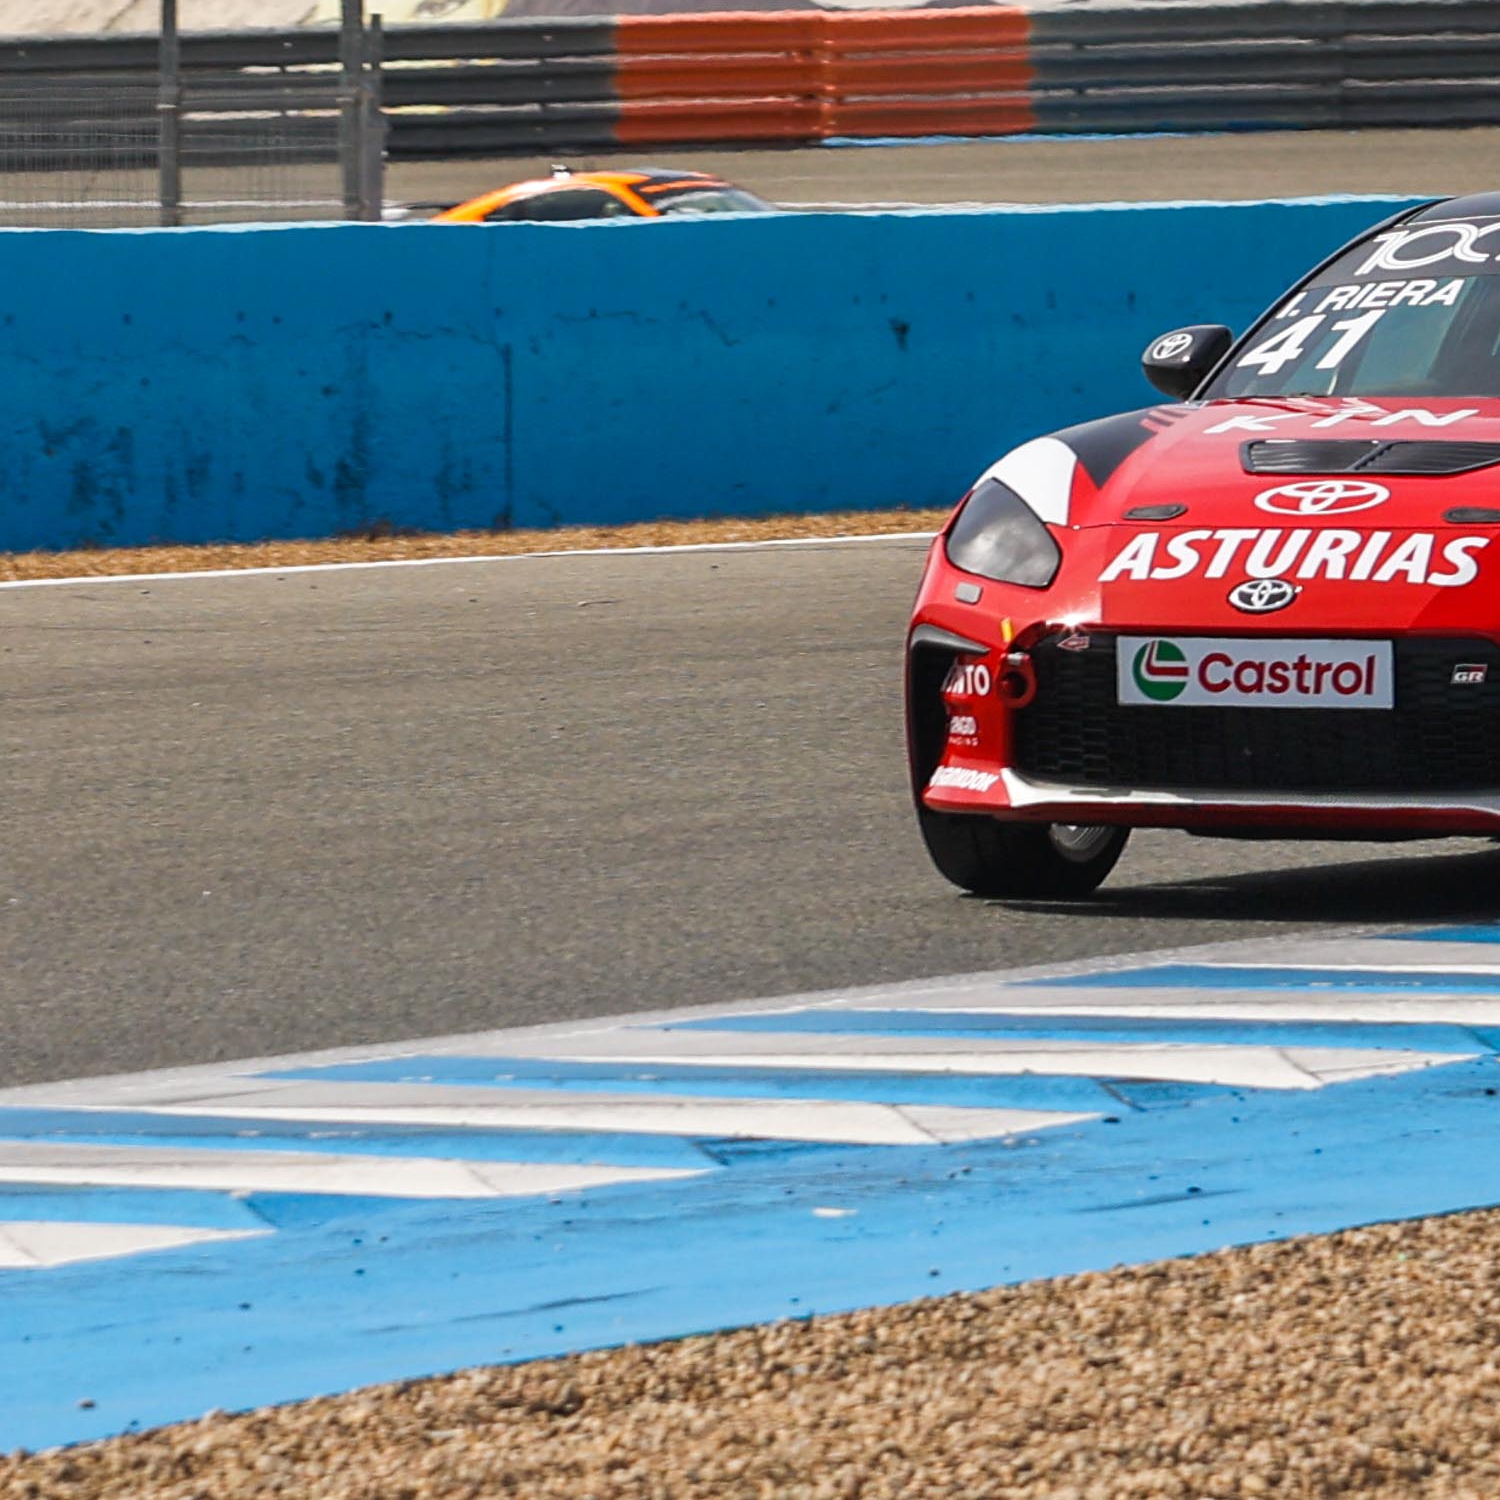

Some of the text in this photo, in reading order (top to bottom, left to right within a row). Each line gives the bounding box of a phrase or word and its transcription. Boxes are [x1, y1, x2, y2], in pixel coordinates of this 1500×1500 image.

[1317, 278, 1466, 313] RIERA
[1236, 309, 1388, 376] 41
[1098, 527, 1491, 587] ASTURIAS
[1198, 651, 1376, 696] Castrol
[1453, 671, 1486, 684] GR
